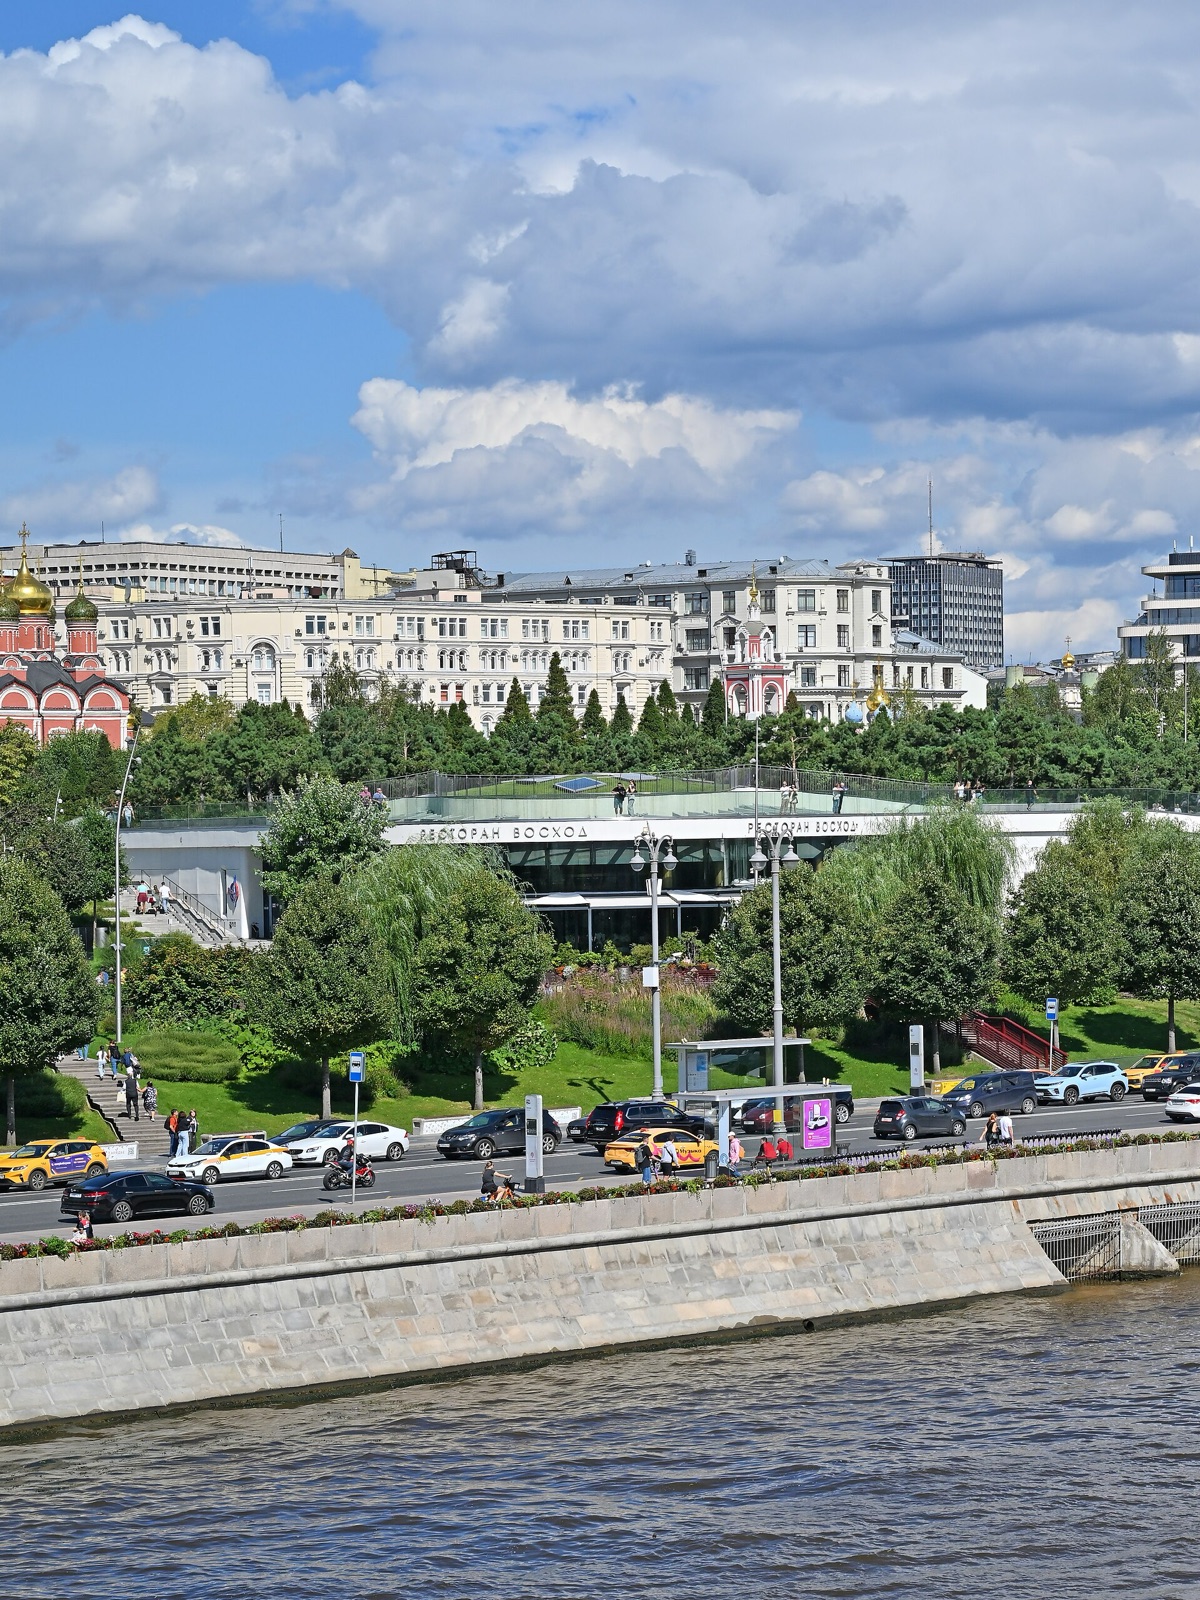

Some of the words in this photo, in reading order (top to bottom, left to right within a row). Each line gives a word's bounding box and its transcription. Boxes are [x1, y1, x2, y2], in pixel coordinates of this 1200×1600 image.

[420, 827, 500, 841] РЕСТОРАН
[513, 826, 588, 839] ВОСХОД
[748, 822, 809, 833] РЕСТОРАН
[816, 821, 856, 832] ВОСХОД
